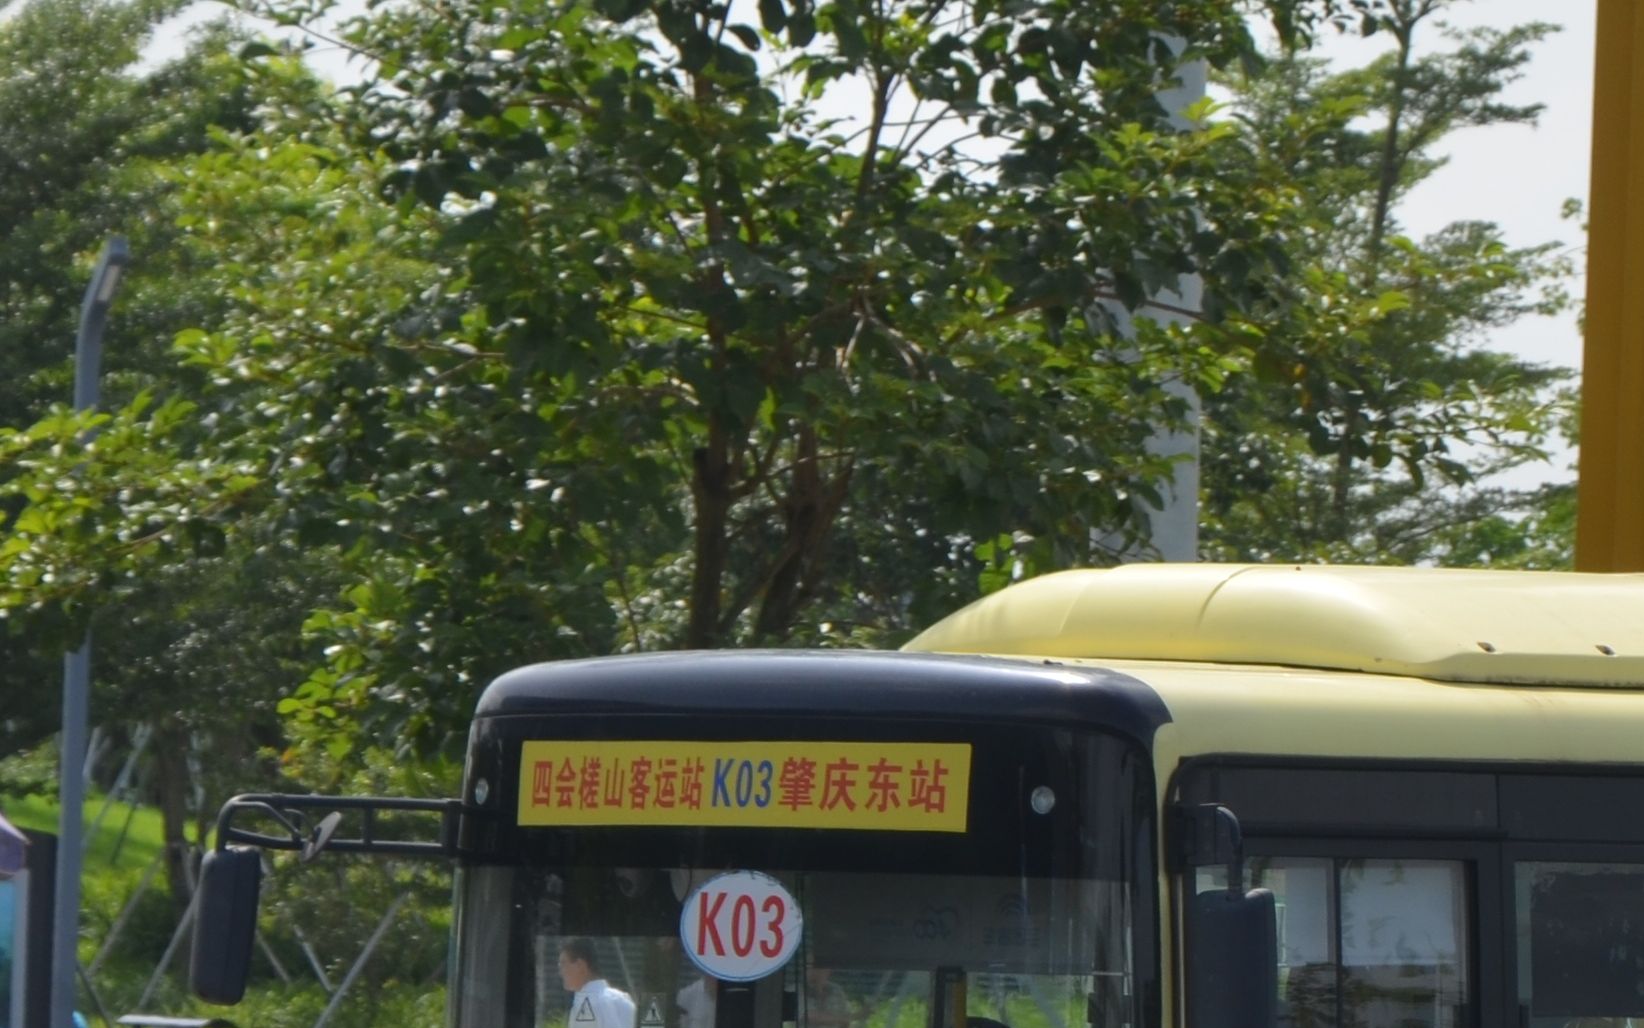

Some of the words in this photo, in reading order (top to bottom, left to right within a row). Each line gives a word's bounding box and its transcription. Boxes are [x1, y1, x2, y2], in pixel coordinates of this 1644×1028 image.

[711, 758, 774, 808] K03
[778, 757, 949, 813] 肇庆东站
[697, 892, 786, 958] K03
